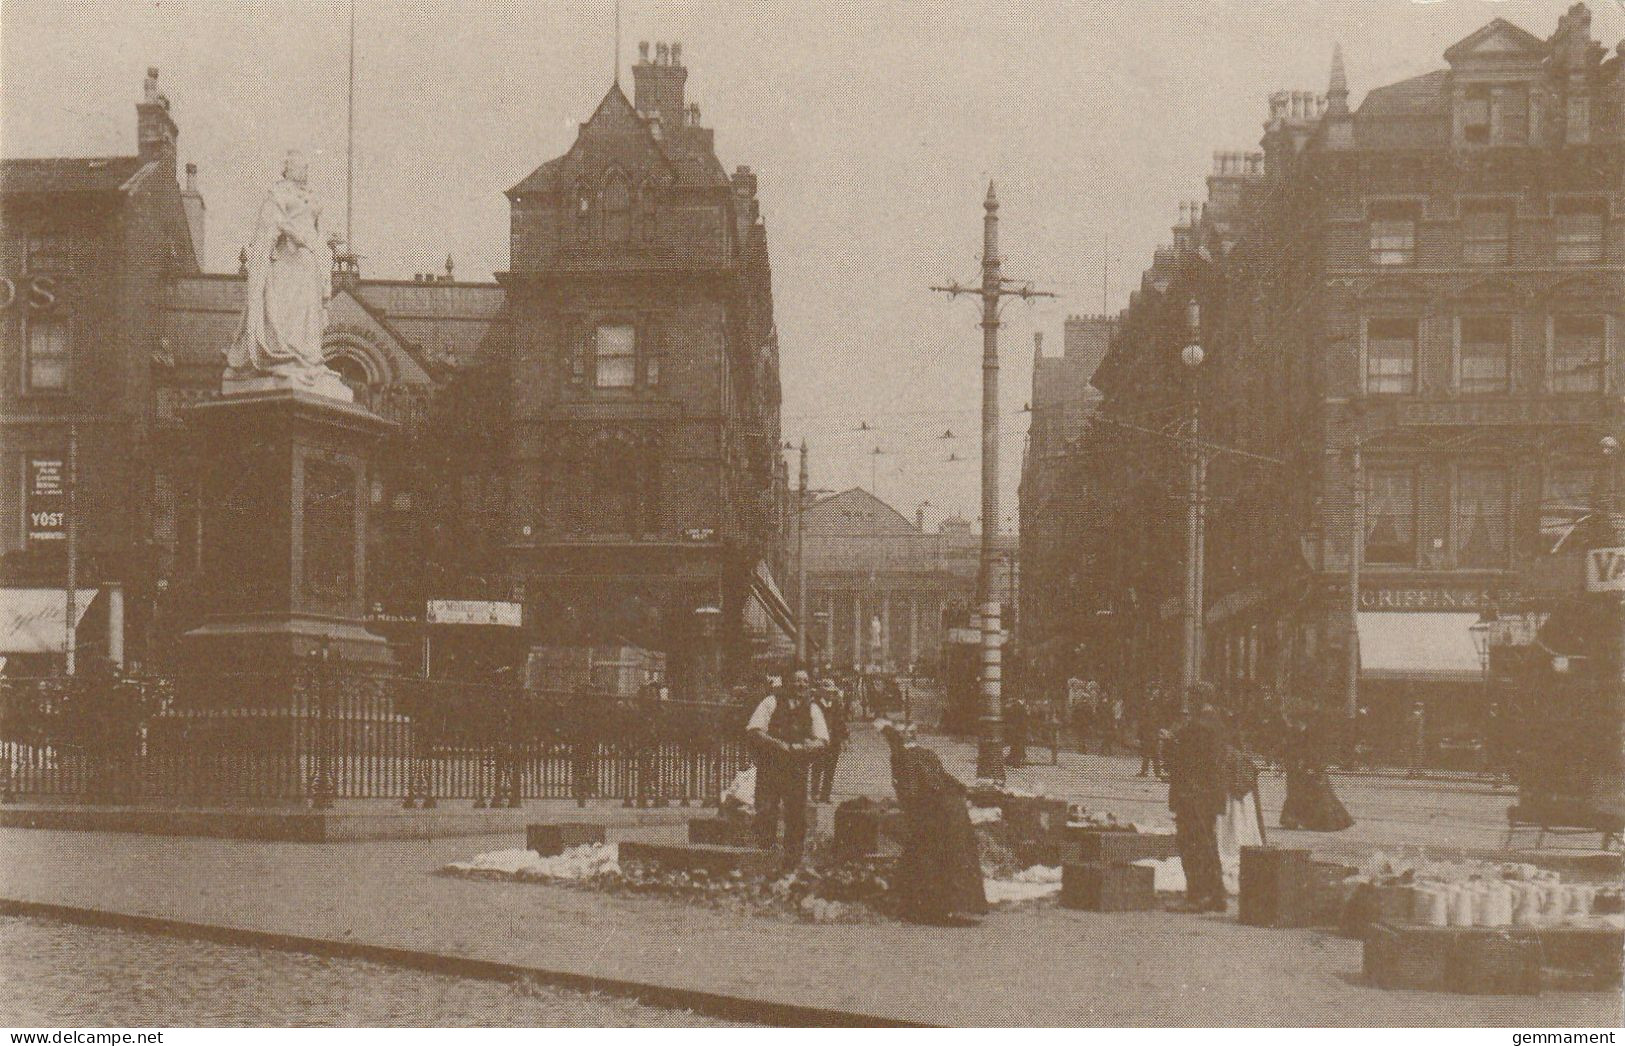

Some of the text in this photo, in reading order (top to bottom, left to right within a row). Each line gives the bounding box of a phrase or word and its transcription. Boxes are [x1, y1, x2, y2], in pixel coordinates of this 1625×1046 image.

[31, 511, 64, 526] YOST
[1361, 589, 1455, 607] GRIFFIN
[1461, 590, 1476, 606] &
